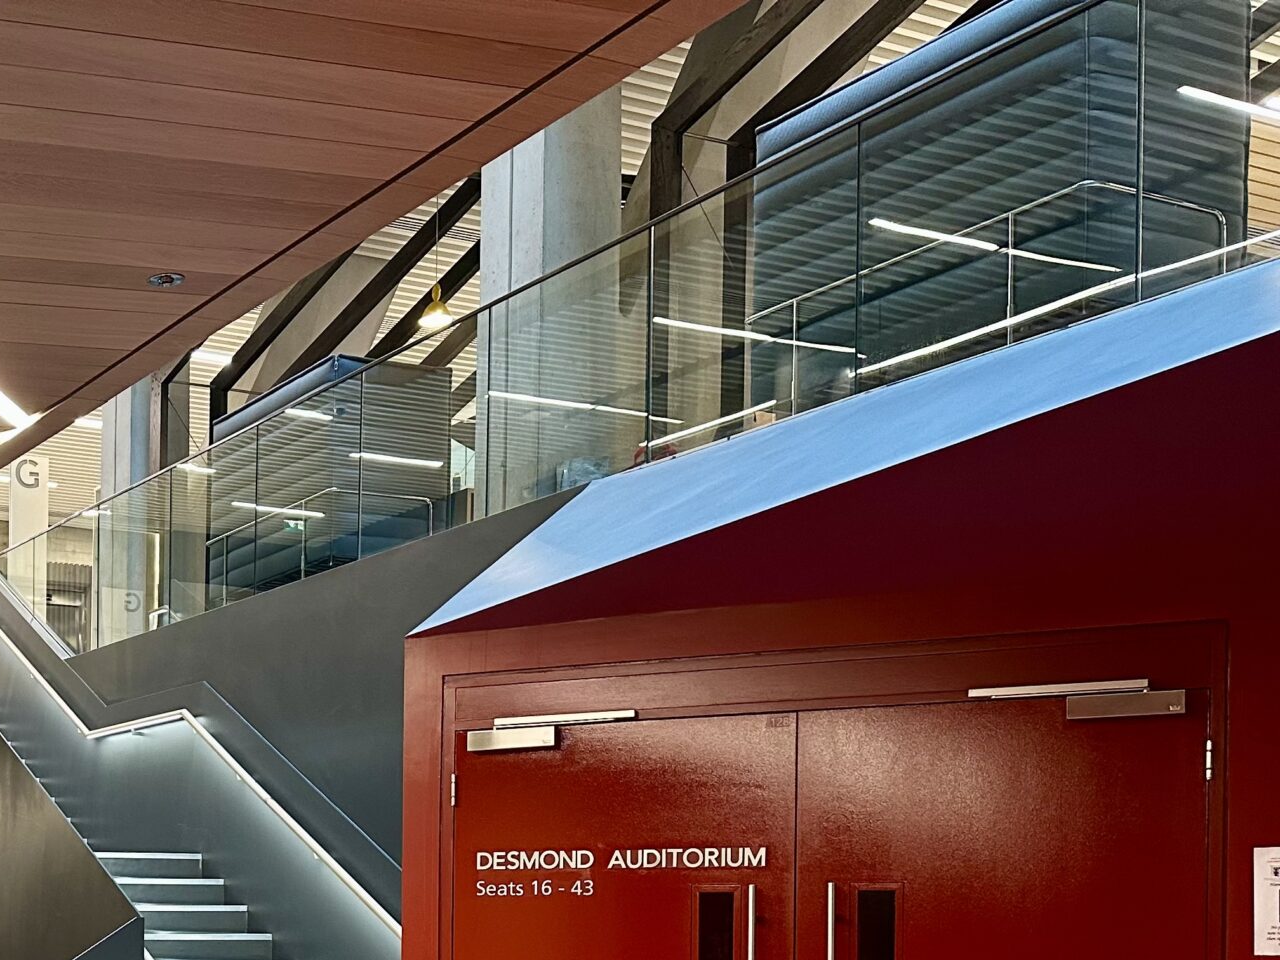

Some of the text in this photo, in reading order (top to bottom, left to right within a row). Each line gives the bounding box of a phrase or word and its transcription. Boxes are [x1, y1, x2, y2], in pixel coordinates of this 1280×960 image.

[15, 459, 40, 489] G
[476, 846, 767, 871] DESMOND AUDITORIUM
[476, 880, 524, 897] Seats
[531, 879, 552, 896] 16
[570, 879, 594, 896] 43
